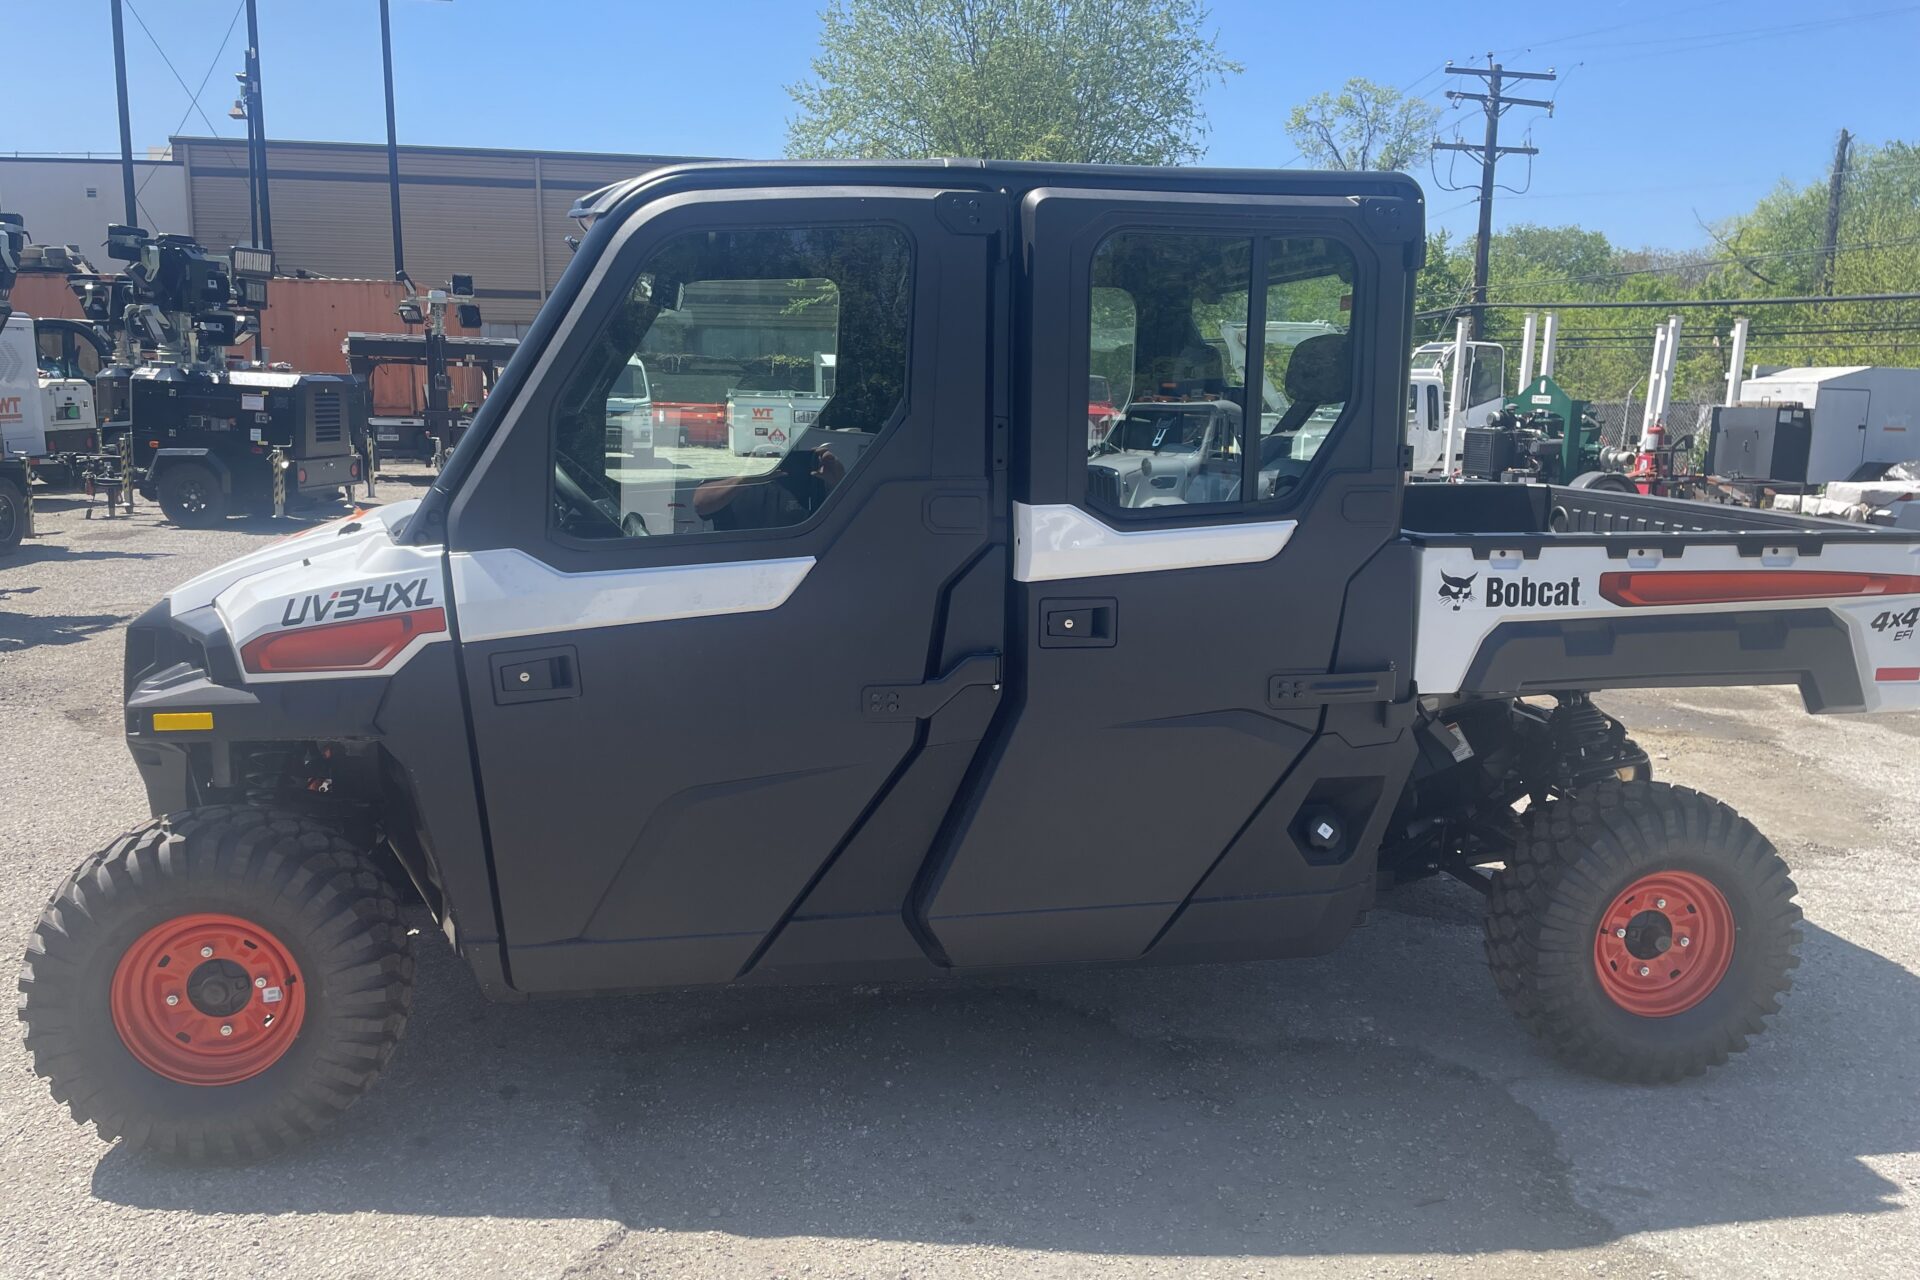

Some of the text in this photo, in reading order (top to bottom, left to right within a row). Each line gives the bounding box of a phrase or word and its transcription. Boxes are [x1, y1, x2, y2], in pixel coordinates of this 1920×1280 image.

[752, 408, 774, 416] WT
[281, 578, 434, 626] UV34XL
[1486, 577, 1580, 607] Bobcat
[1870, 607, 1920, 632] 4x4
[1893, 629, 1914, 641] EFI
